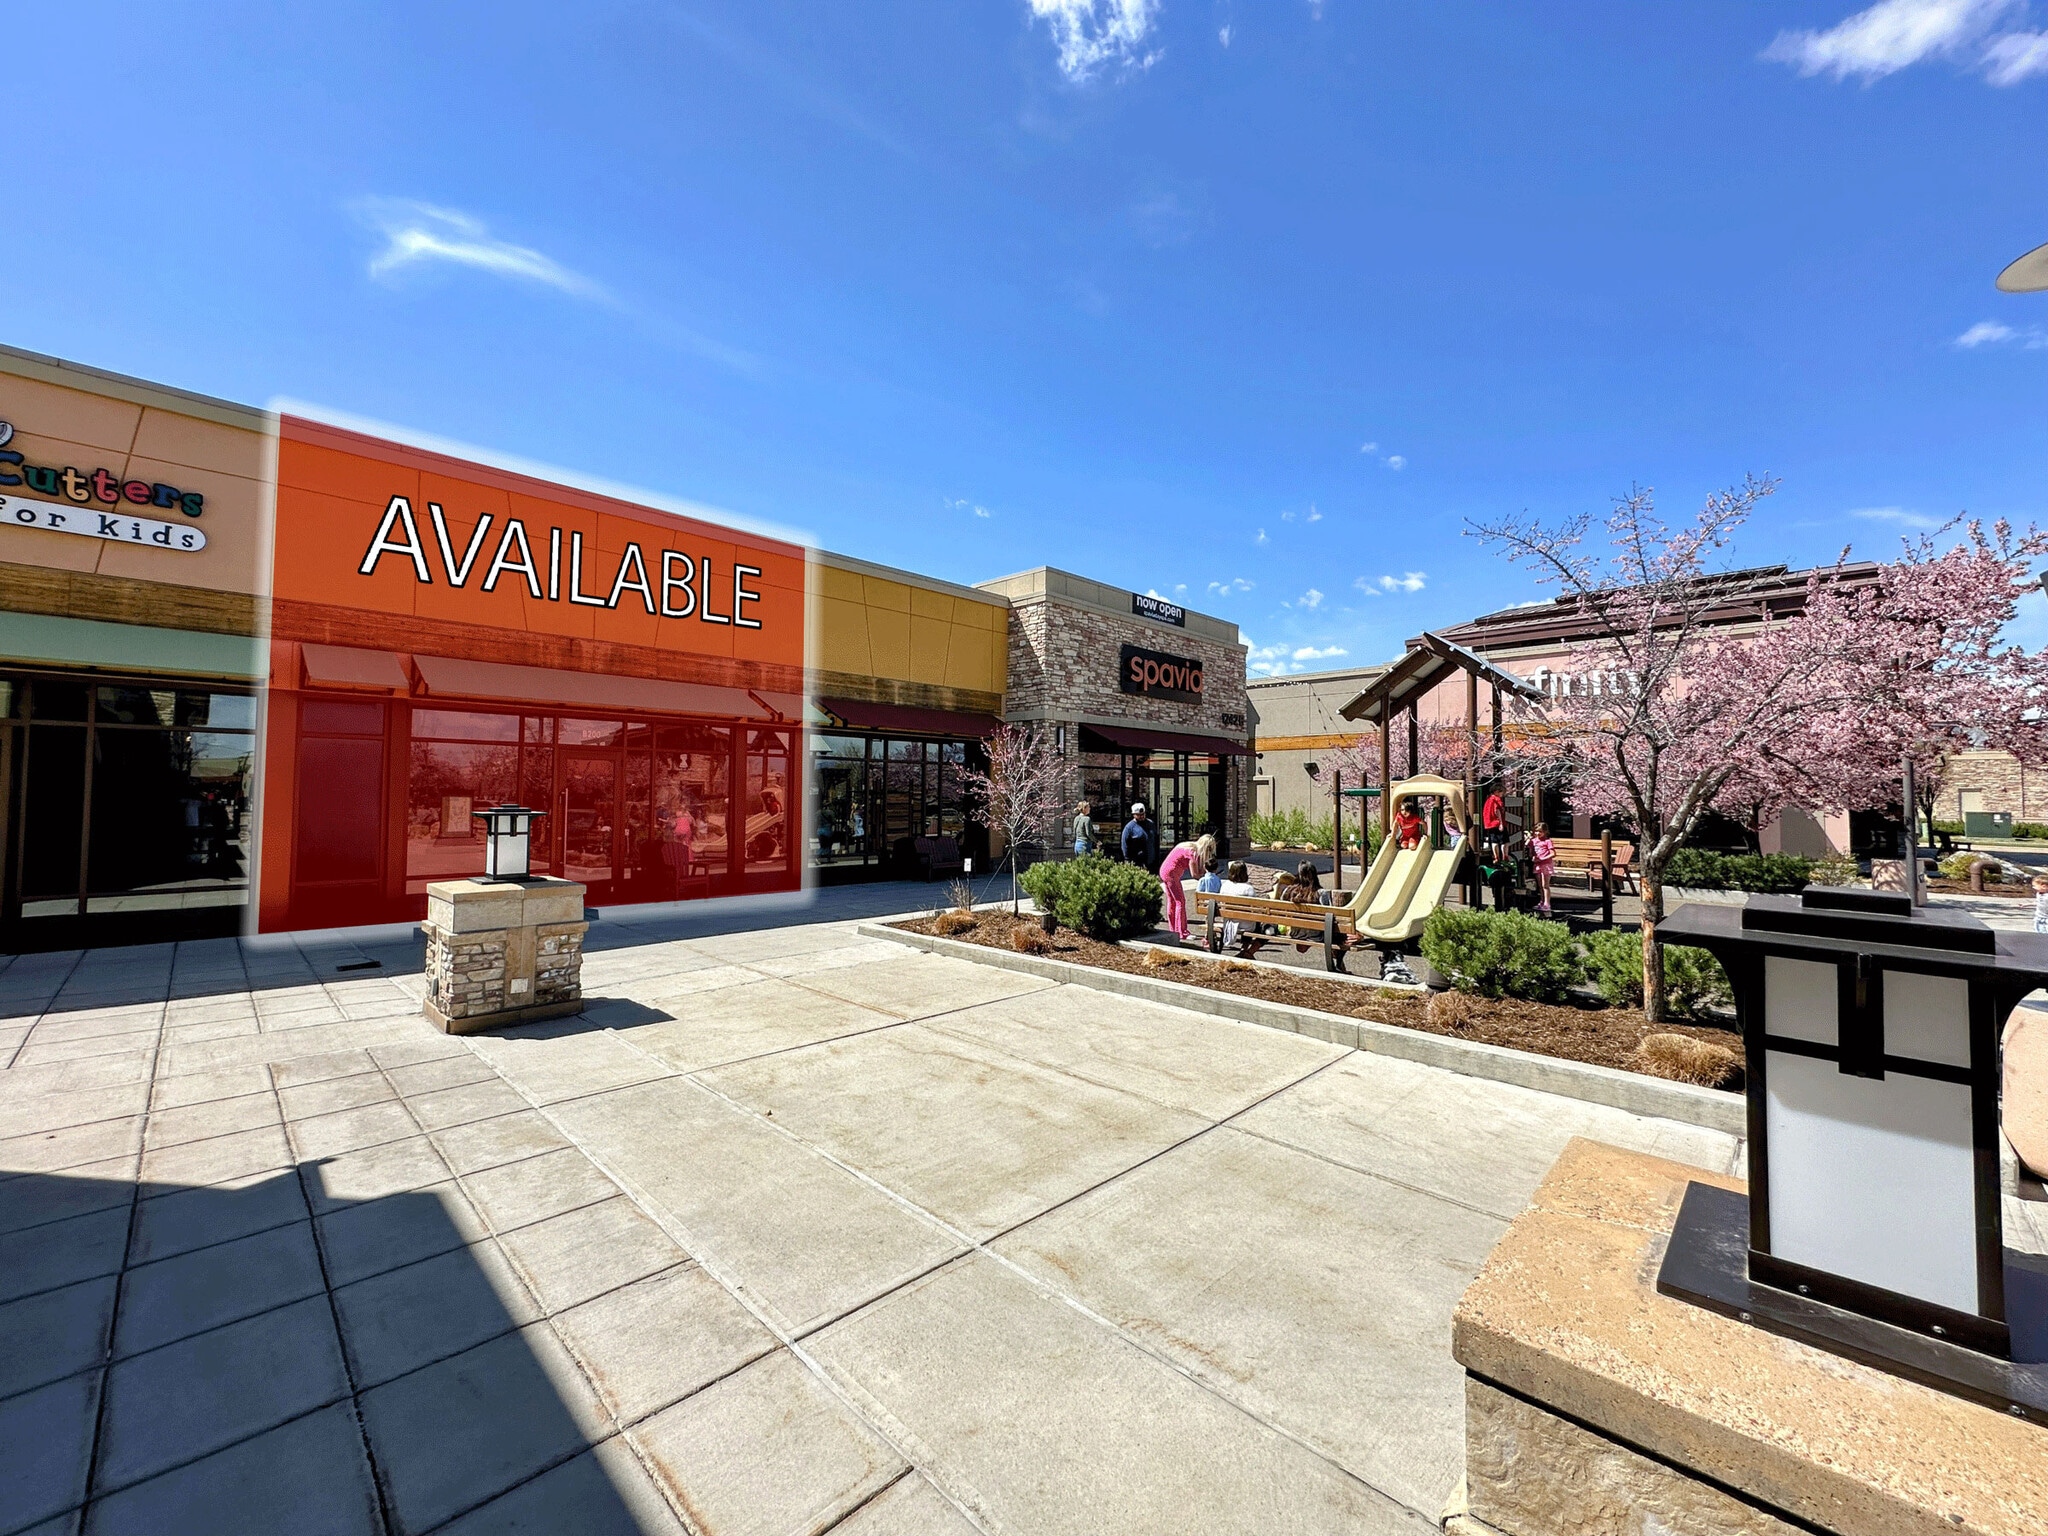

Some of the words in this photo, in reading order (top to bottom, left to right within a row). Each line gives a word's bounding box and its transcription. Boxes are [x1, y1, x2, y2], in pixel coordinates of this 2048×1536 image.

[0, 449, 204, 518] Cutters
[1136, 595, 1158, 611] now
[1159, 603, 1183, 619] open
[1130, 655, 1204, 693] spavia
